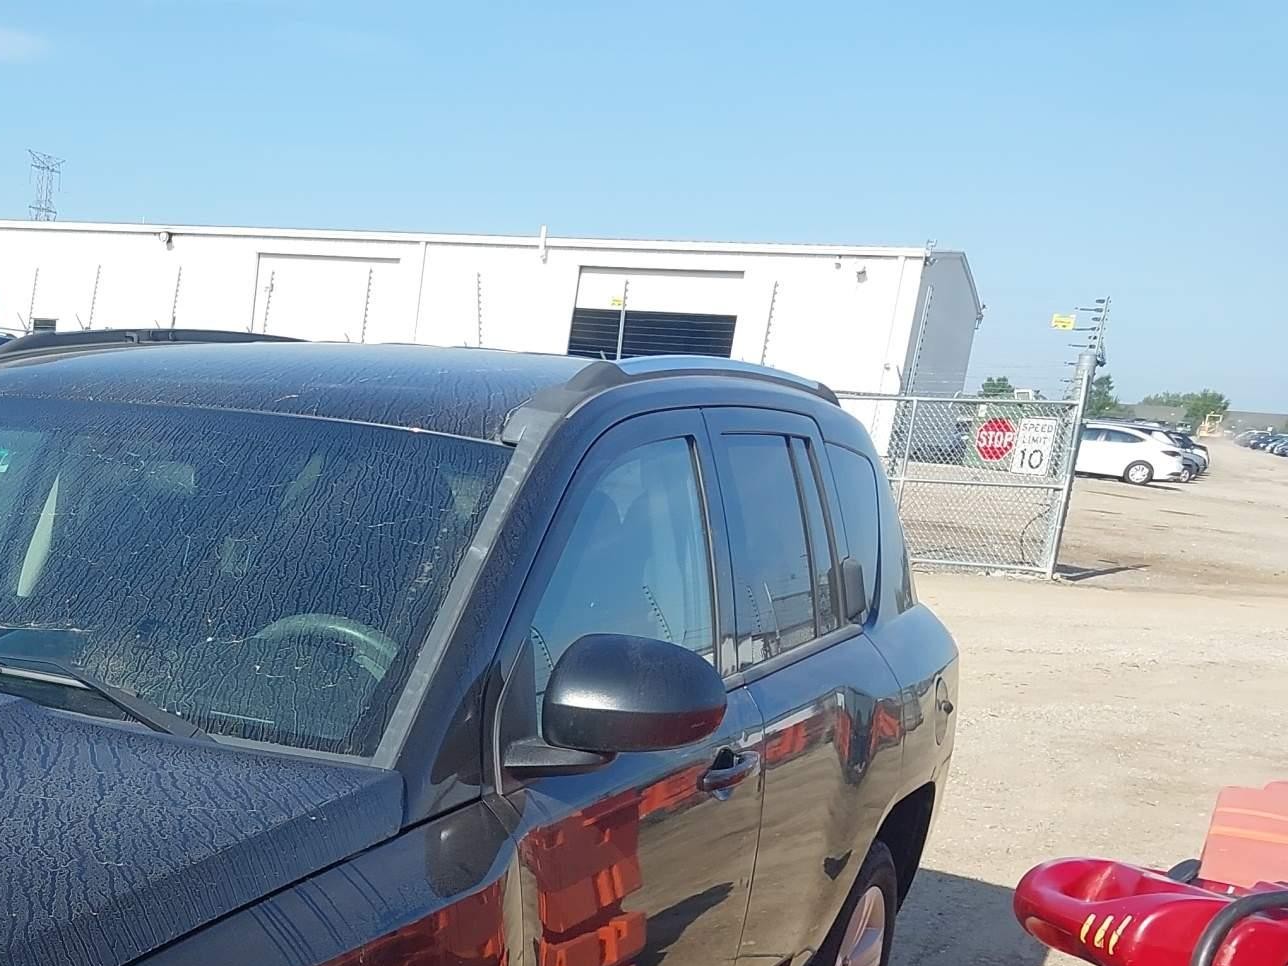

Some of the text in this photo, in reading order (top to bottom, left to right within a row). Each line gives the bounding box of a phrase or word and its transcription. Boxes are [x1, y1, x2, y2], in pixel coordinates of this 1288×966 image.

[1021, 423, 1054, 433] SPEED
[977, 430, 1014, 448] STOP
[1022, 435, 1049, 445] LIMIT
[1019, 448, 1044, 469] 10
